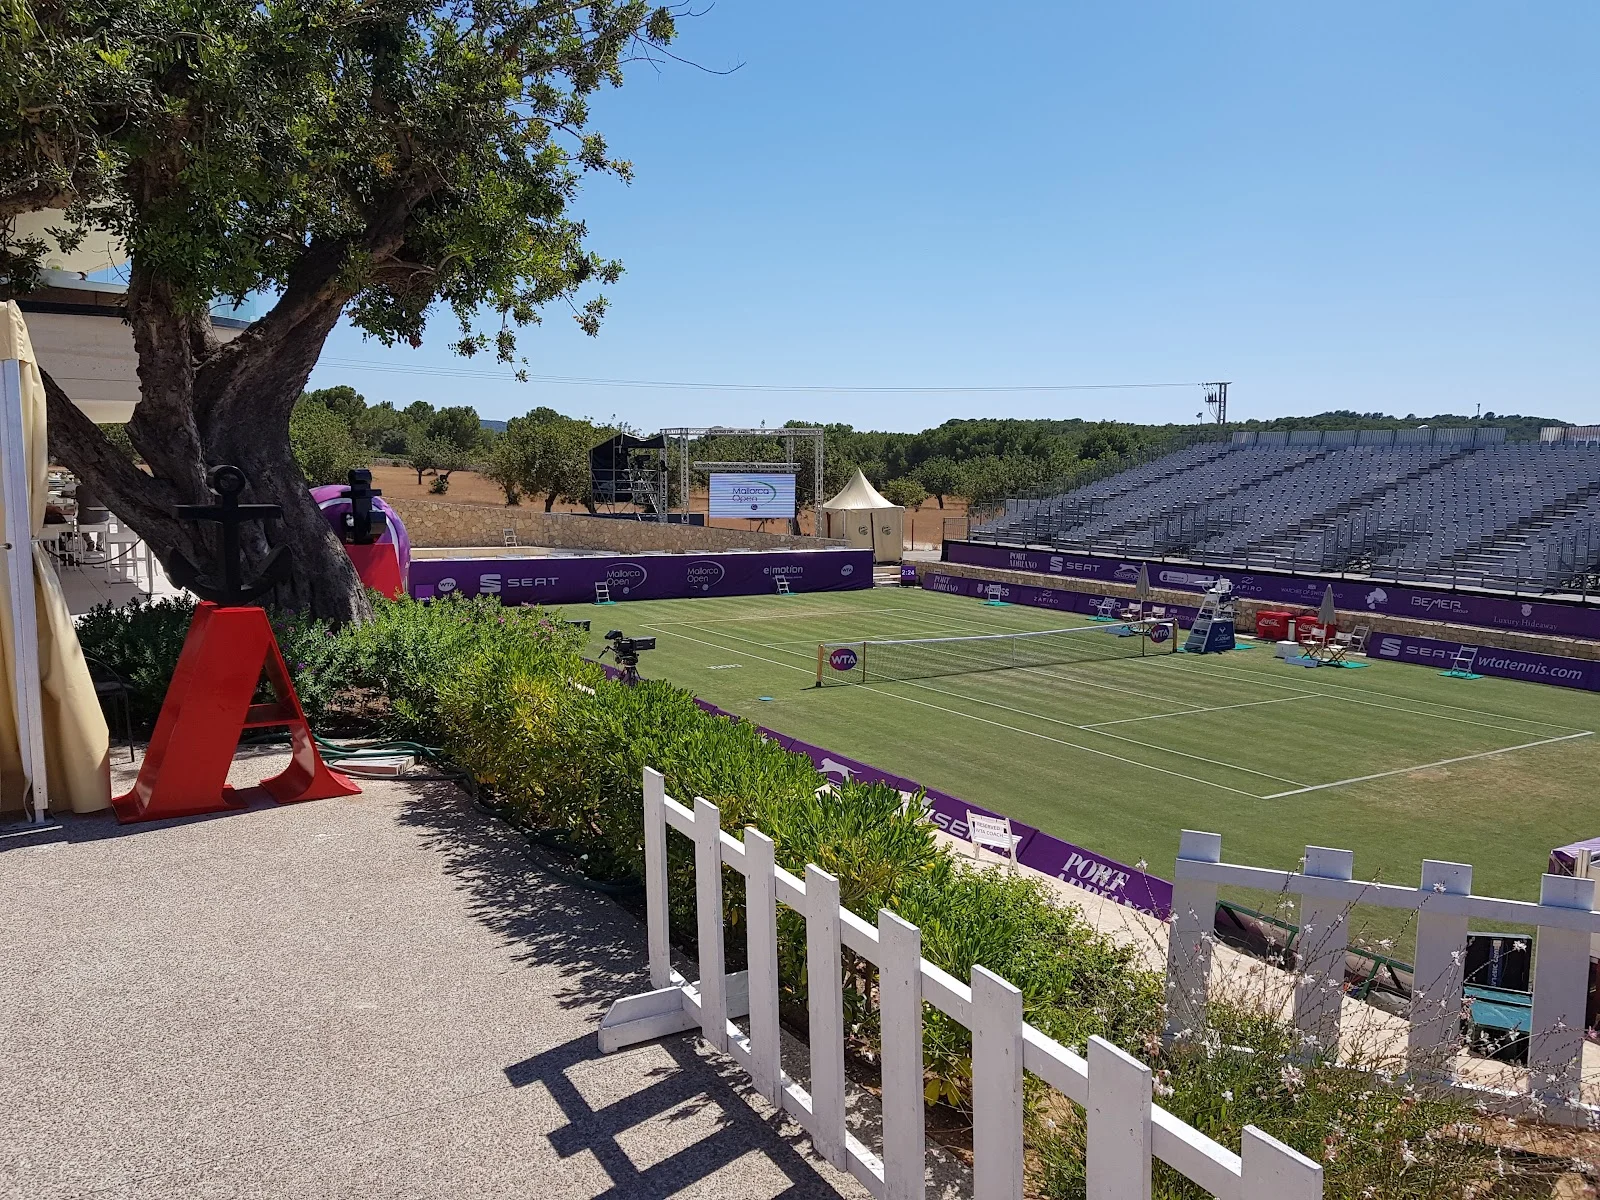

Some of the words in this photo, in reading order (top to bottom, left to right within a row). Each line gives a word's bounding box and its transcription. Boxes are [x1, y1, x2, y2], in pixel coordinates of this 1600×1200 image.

[732, 487, 770, 495] Mallorca
[732, 494, 758, 503] Open
[1009, 551, 1028, 561] PORT
[1007, 559, 1038, 570] ADRIANO
[1066, 562, 1101, 573] SEAT
[606, 569, 641, 579] Mallorca
[687, 567, 719, 576] Mallorca
[507, 577, 560, 588] SEAT
[606, 577, 630, 587] Open
[686, 574, 709, 584] Open
[1410, 596, 1462, 611] BEMER
[1493, 615, 1520, 627] Luxury
[1521, 618, 1558, 631] Hideaway
[1151, 628, 1169, 639] WTA
[1405, 645, 1458, 659] SEAT
[831, 655, 856, 665] WTA
[1477, 655, 1583, 681] wtatennis.com
[976, 821, 1001, 831] RESERVED
[986, 830, 1004, 838] COACH
[1061, 852, 1131, 892] PORT
